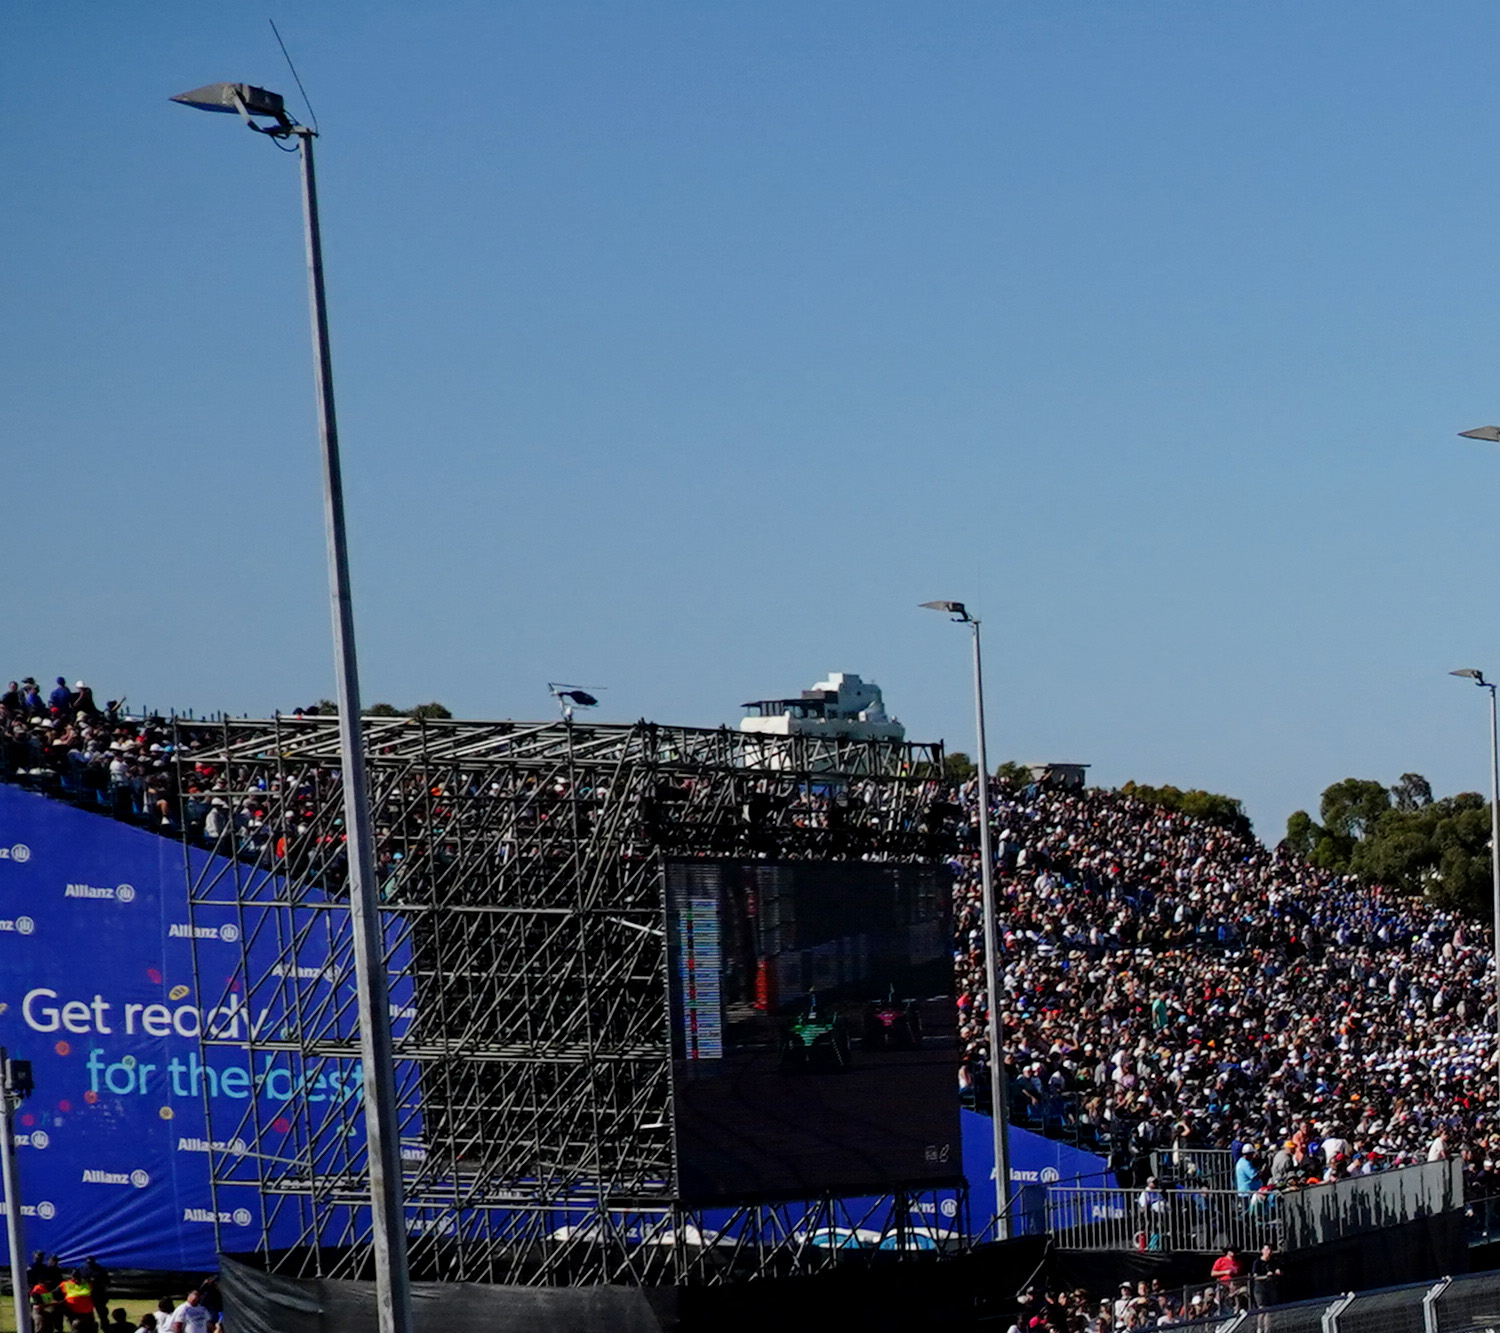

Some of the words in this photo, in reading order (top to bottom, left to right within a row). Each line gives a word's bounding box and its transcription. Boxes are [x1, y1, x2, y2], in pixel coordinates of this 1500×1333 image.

[65, 884, 114, 899] Allianz
[169, 924, 218, 939] Allianz
[22, 988, 112, 1034] Get
[125, 993, 268, 1048] ready
[86, 1048, 156, 1095] for
[168, 1053, 250, 1098] the
[177, 1137, 226, 1151] Allianz
[82, 1168, 130, 1185] Allianz
[183, 1207, 232, 1223] Allianz
